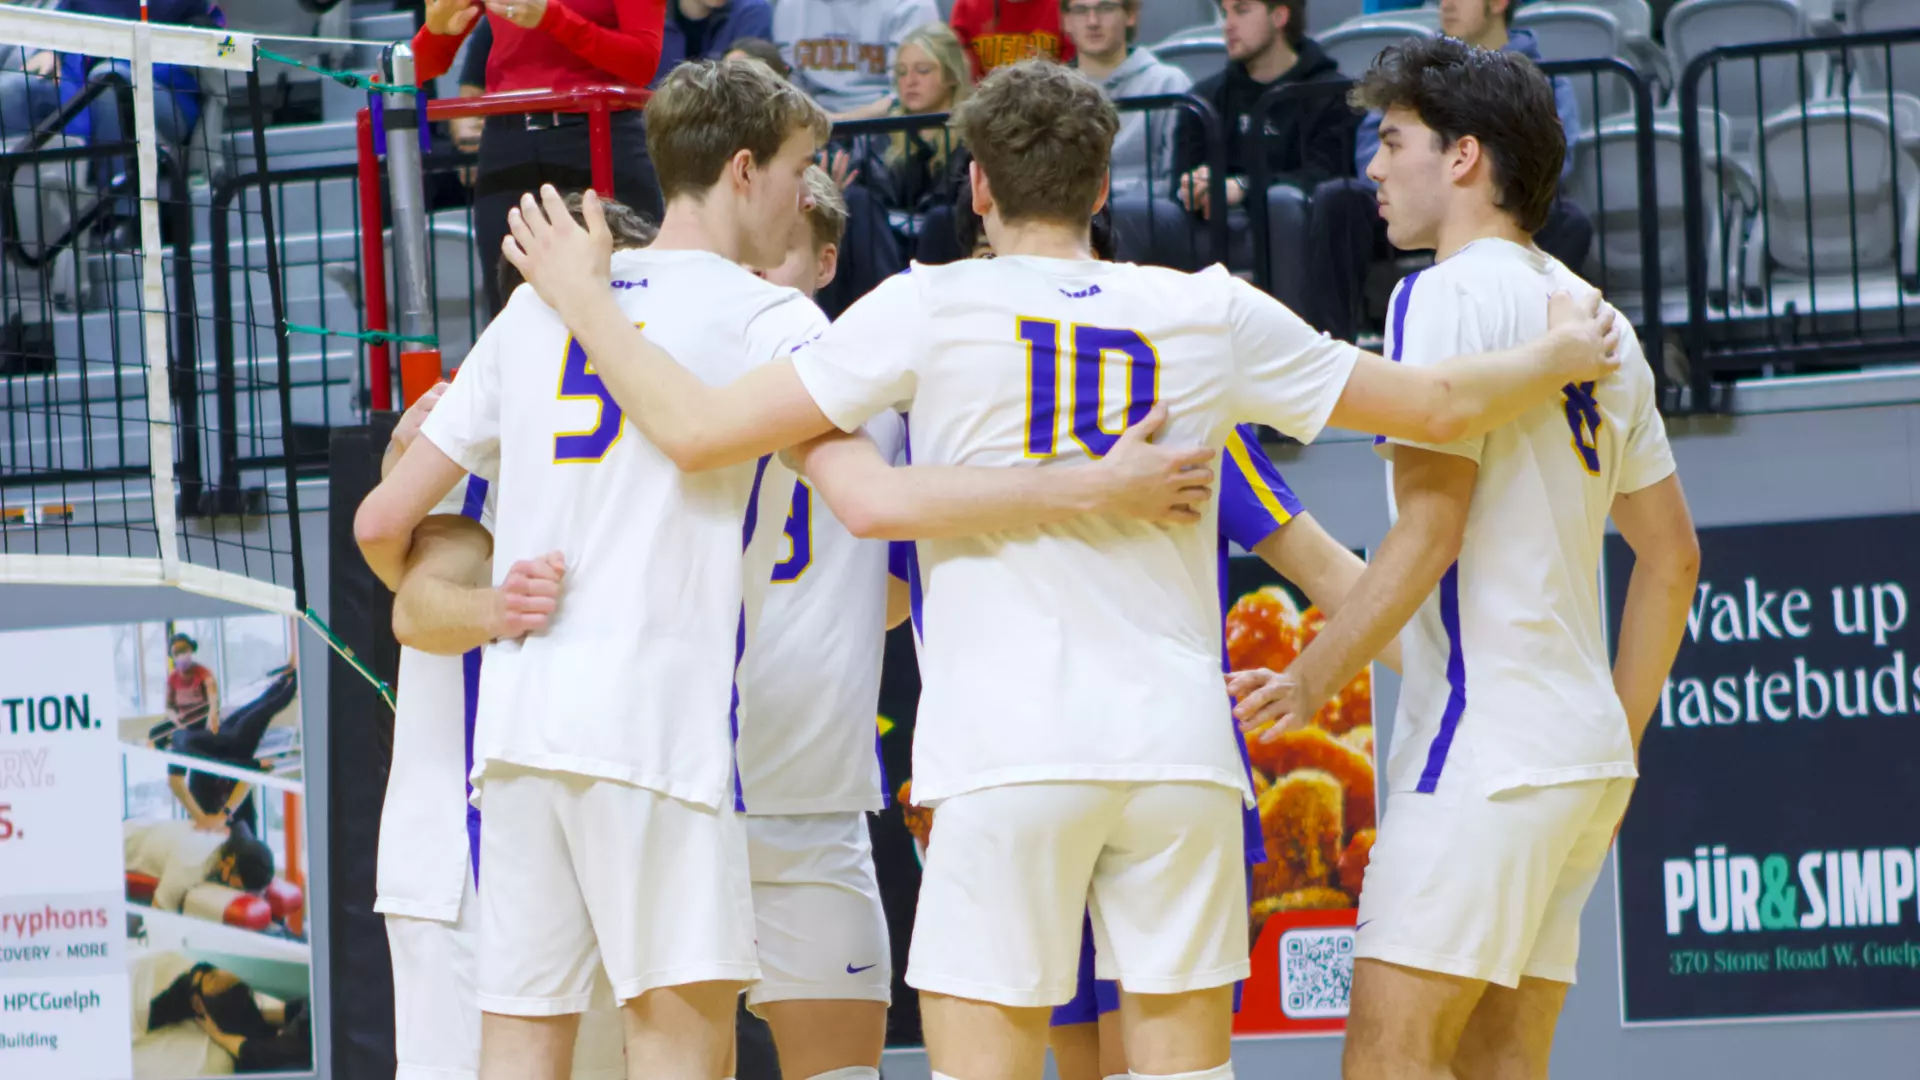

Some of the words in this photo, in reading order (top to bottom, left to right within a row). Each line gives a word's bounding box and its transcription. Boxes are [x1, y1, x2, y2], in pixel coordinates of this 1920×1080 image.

[1016, 315, 1160, 460] 10
[1831, 582, 1907, 646] up
[1, 693, 102, 734] TION.
[1660, 649, 1920, 728] tastebud
[1663, 845, 1920, 935] PÜR&SIMP
[66, 943, 108, 959] MORE
[1669, 949, 1708, 975] 370
[1713, 949, 1769, 973] Stone
[1775, 945, 1827, 970] Road
[1832, 942, 1858, 968] W,
[3, 989, 101, 1013] HPCGuelph
